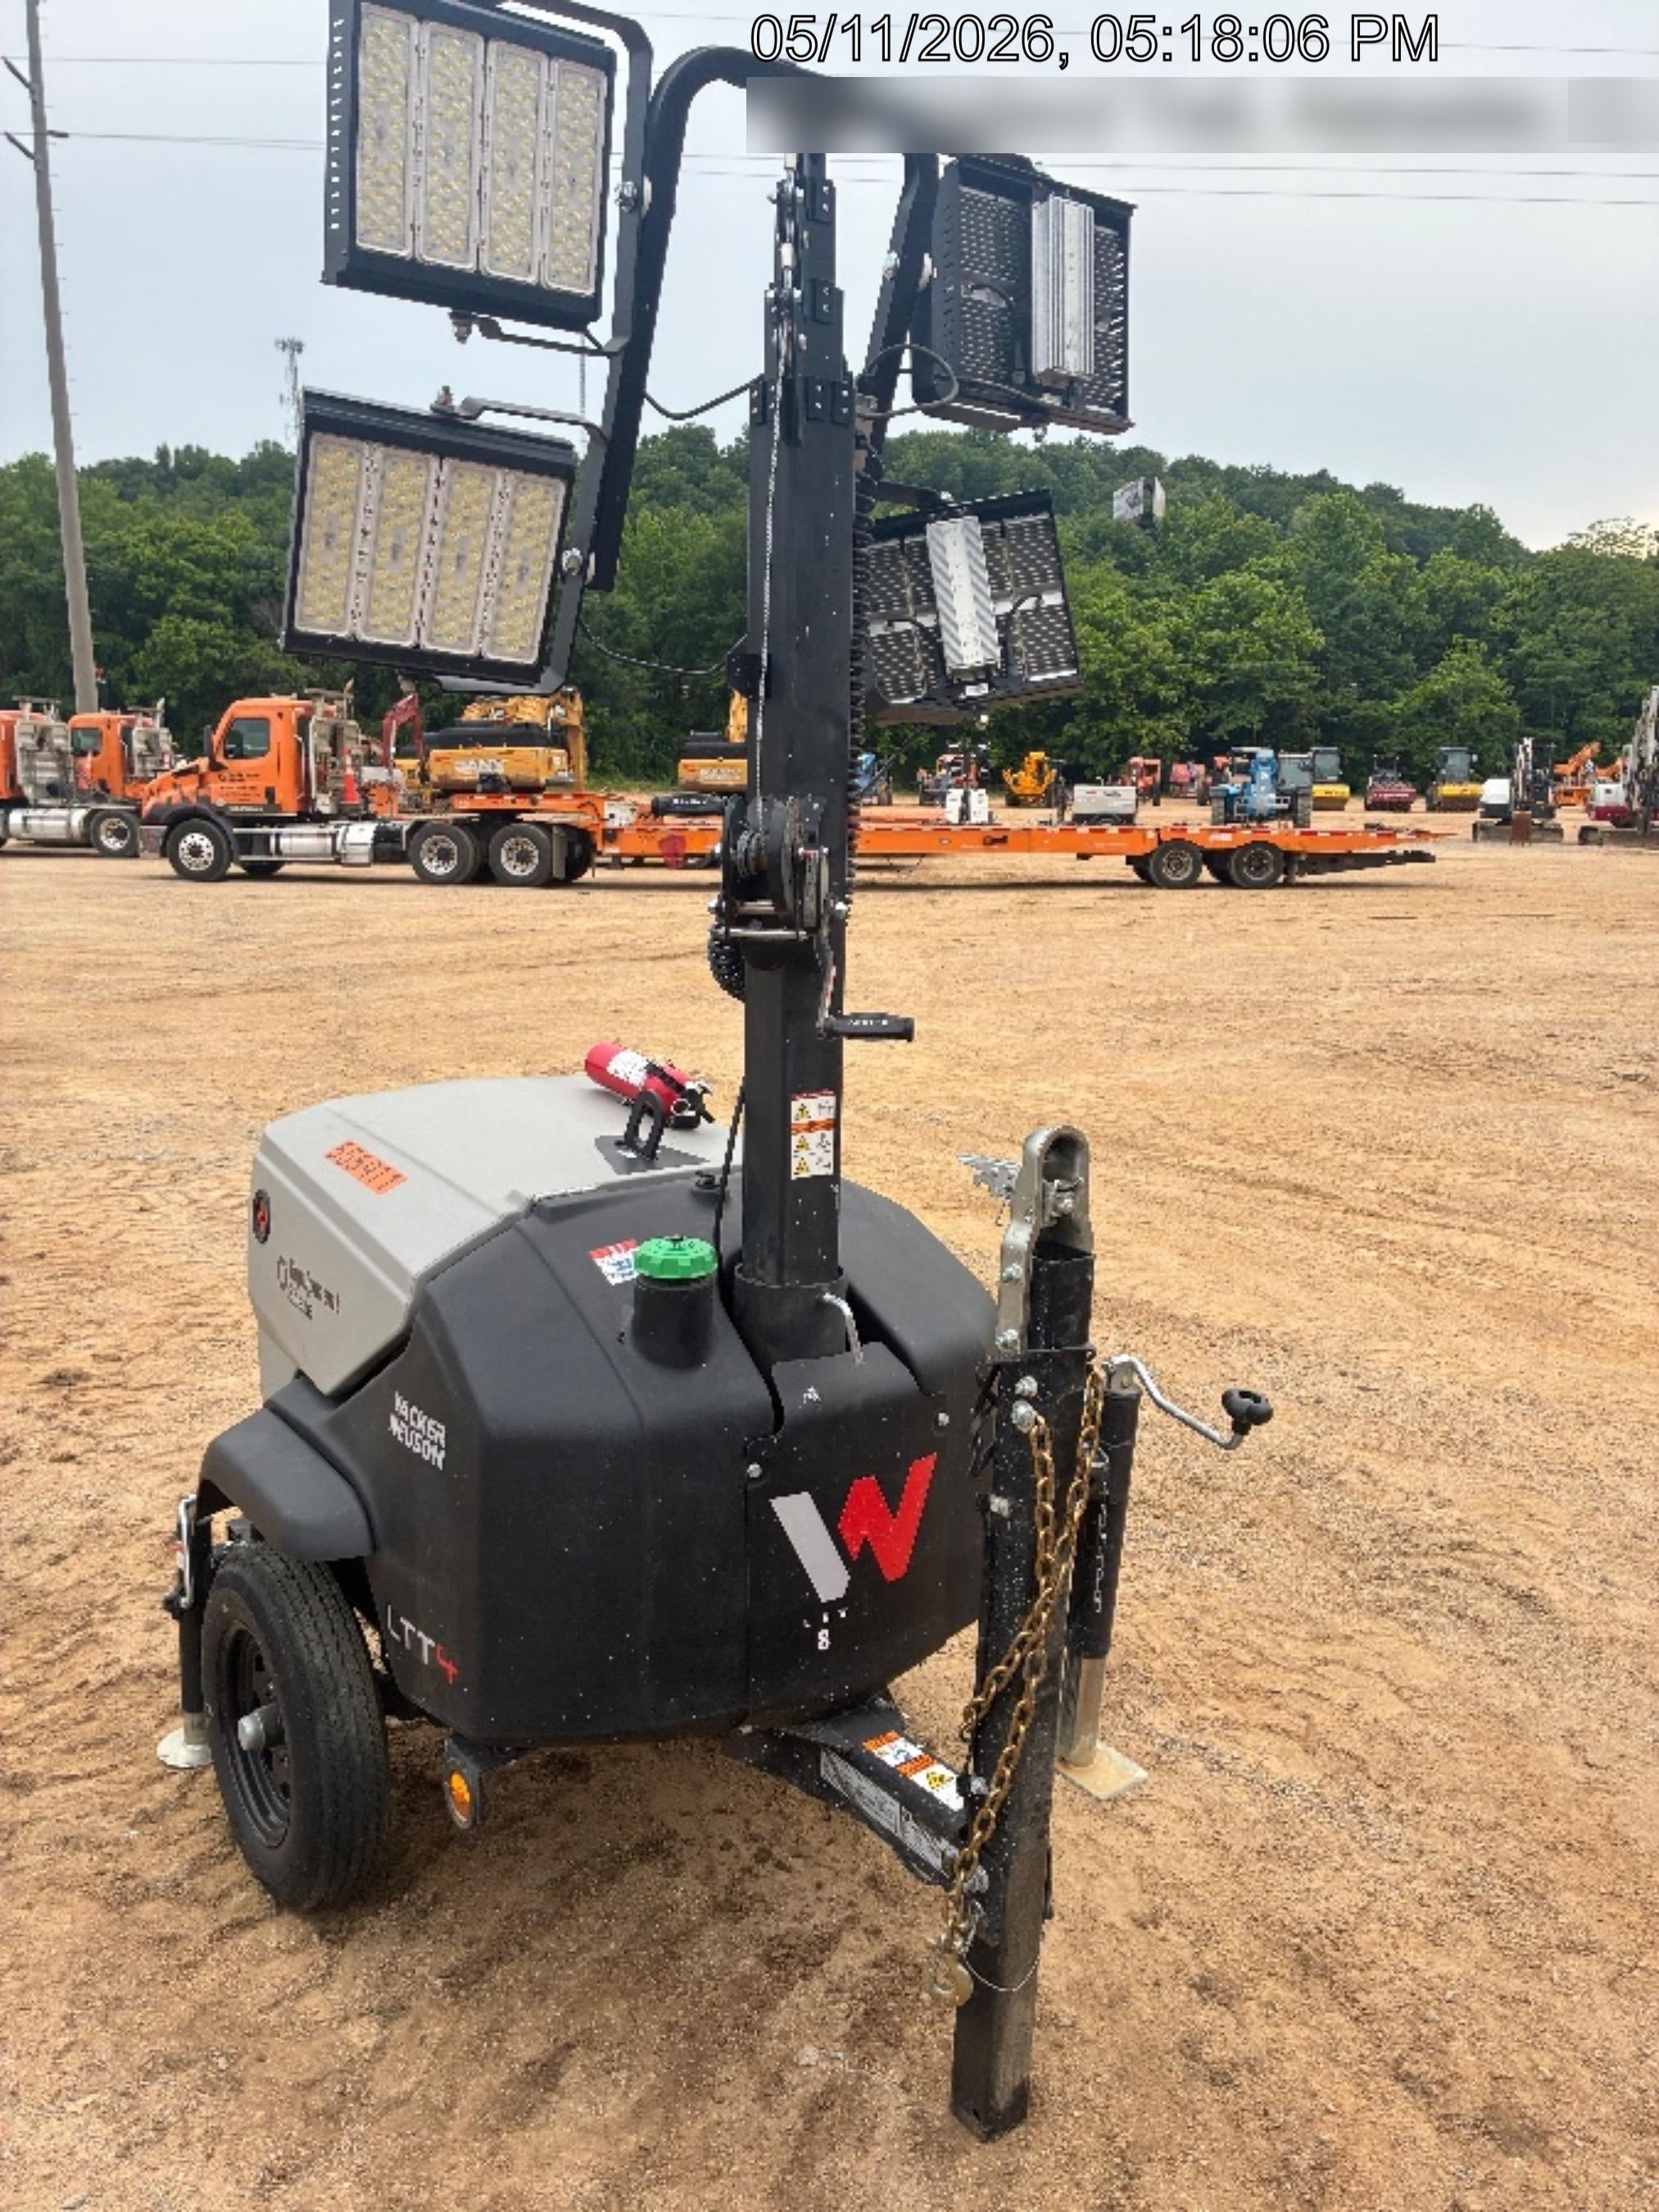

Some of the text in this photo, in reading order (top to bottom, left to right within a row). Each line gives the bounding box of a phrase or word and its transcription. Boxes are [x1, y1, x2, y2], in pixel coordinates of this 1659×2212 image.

[389, 1412, 446, 1471] NEUSON
[395, 1390, 446, 1448] WACKER
[388, 1604, 459, 1685] LTT4
